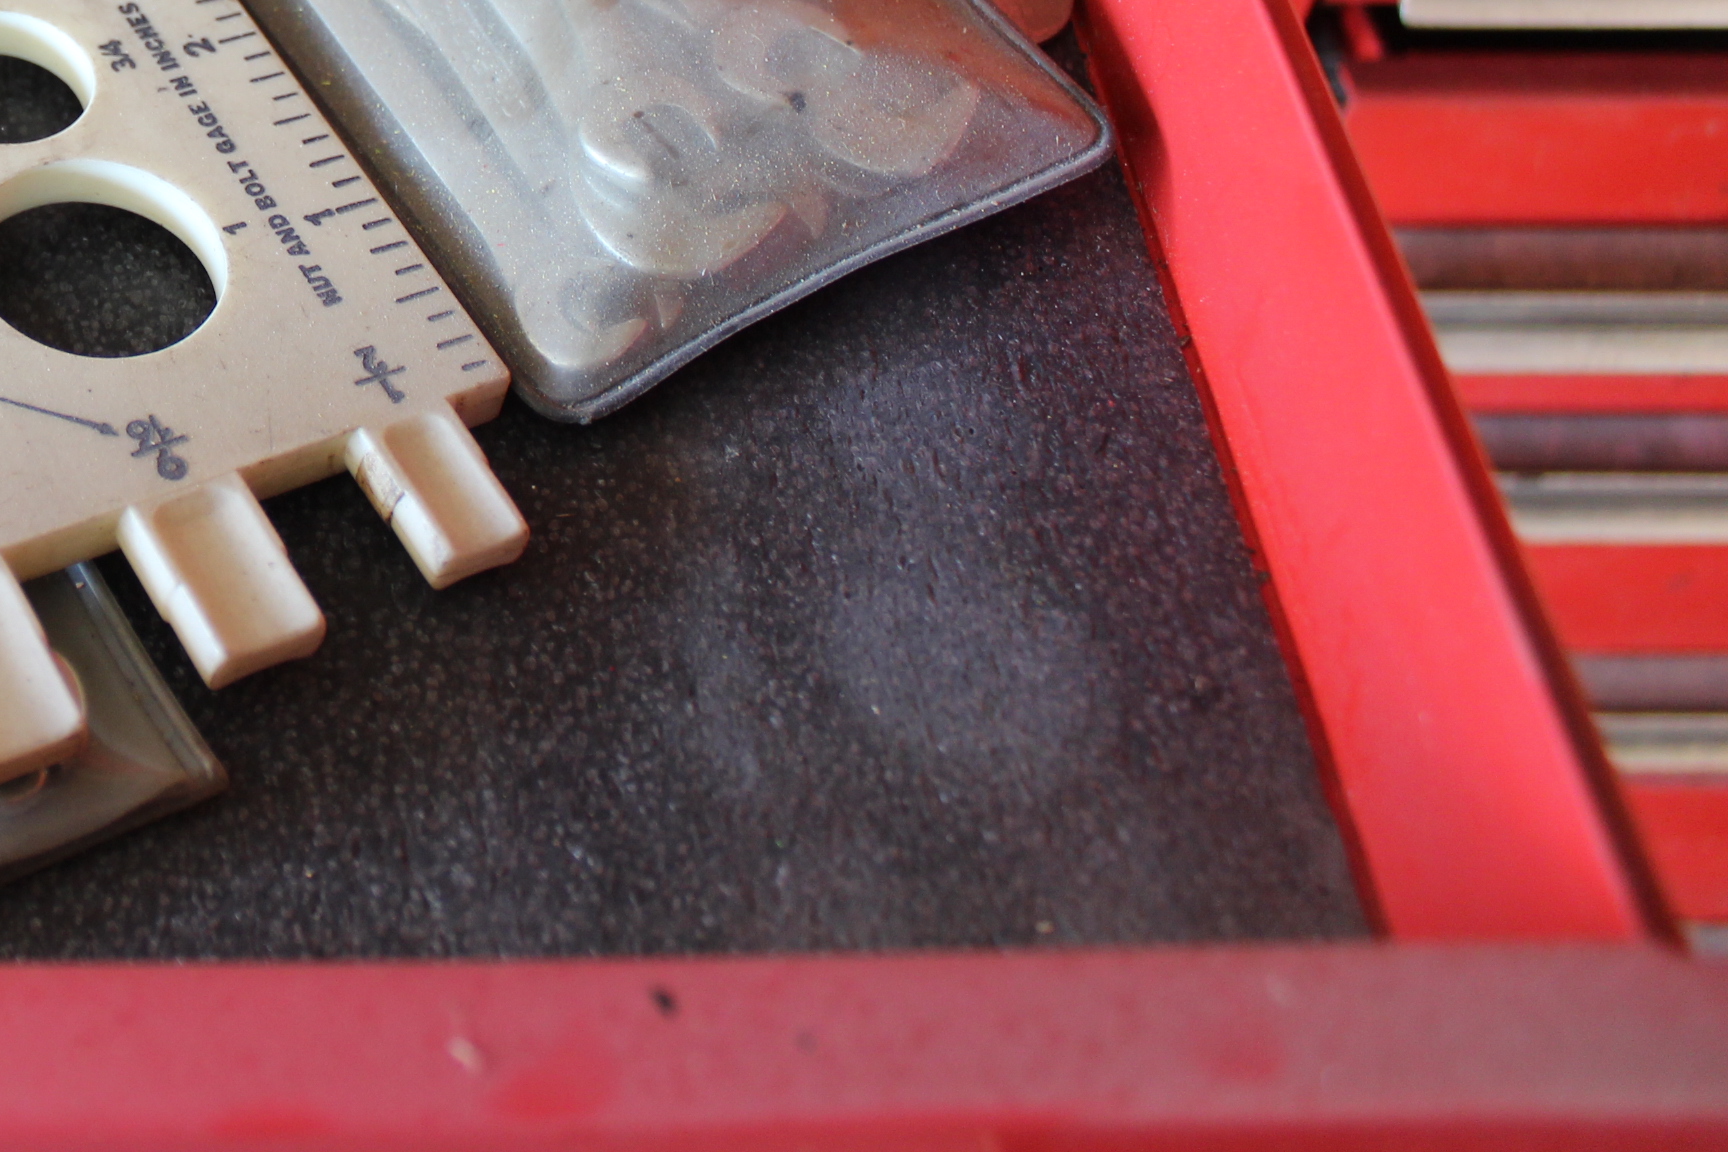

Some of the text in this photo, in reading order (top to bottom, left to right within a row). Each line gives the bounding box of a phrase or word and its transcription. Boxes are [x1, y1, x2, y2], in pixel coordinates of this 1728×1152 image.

[98, 40, 136, 72] 3/4
[183, 35, 216, 57] 2
[114, 2, 342, 306] NUT AND BOLT GAGE IN INCHES
[222, 222, 247, 235] 1
[303, 209, 335, 226] 1
[354, 345, 406, 404] 1/2
[126, 414, 188, 481] 9/16
